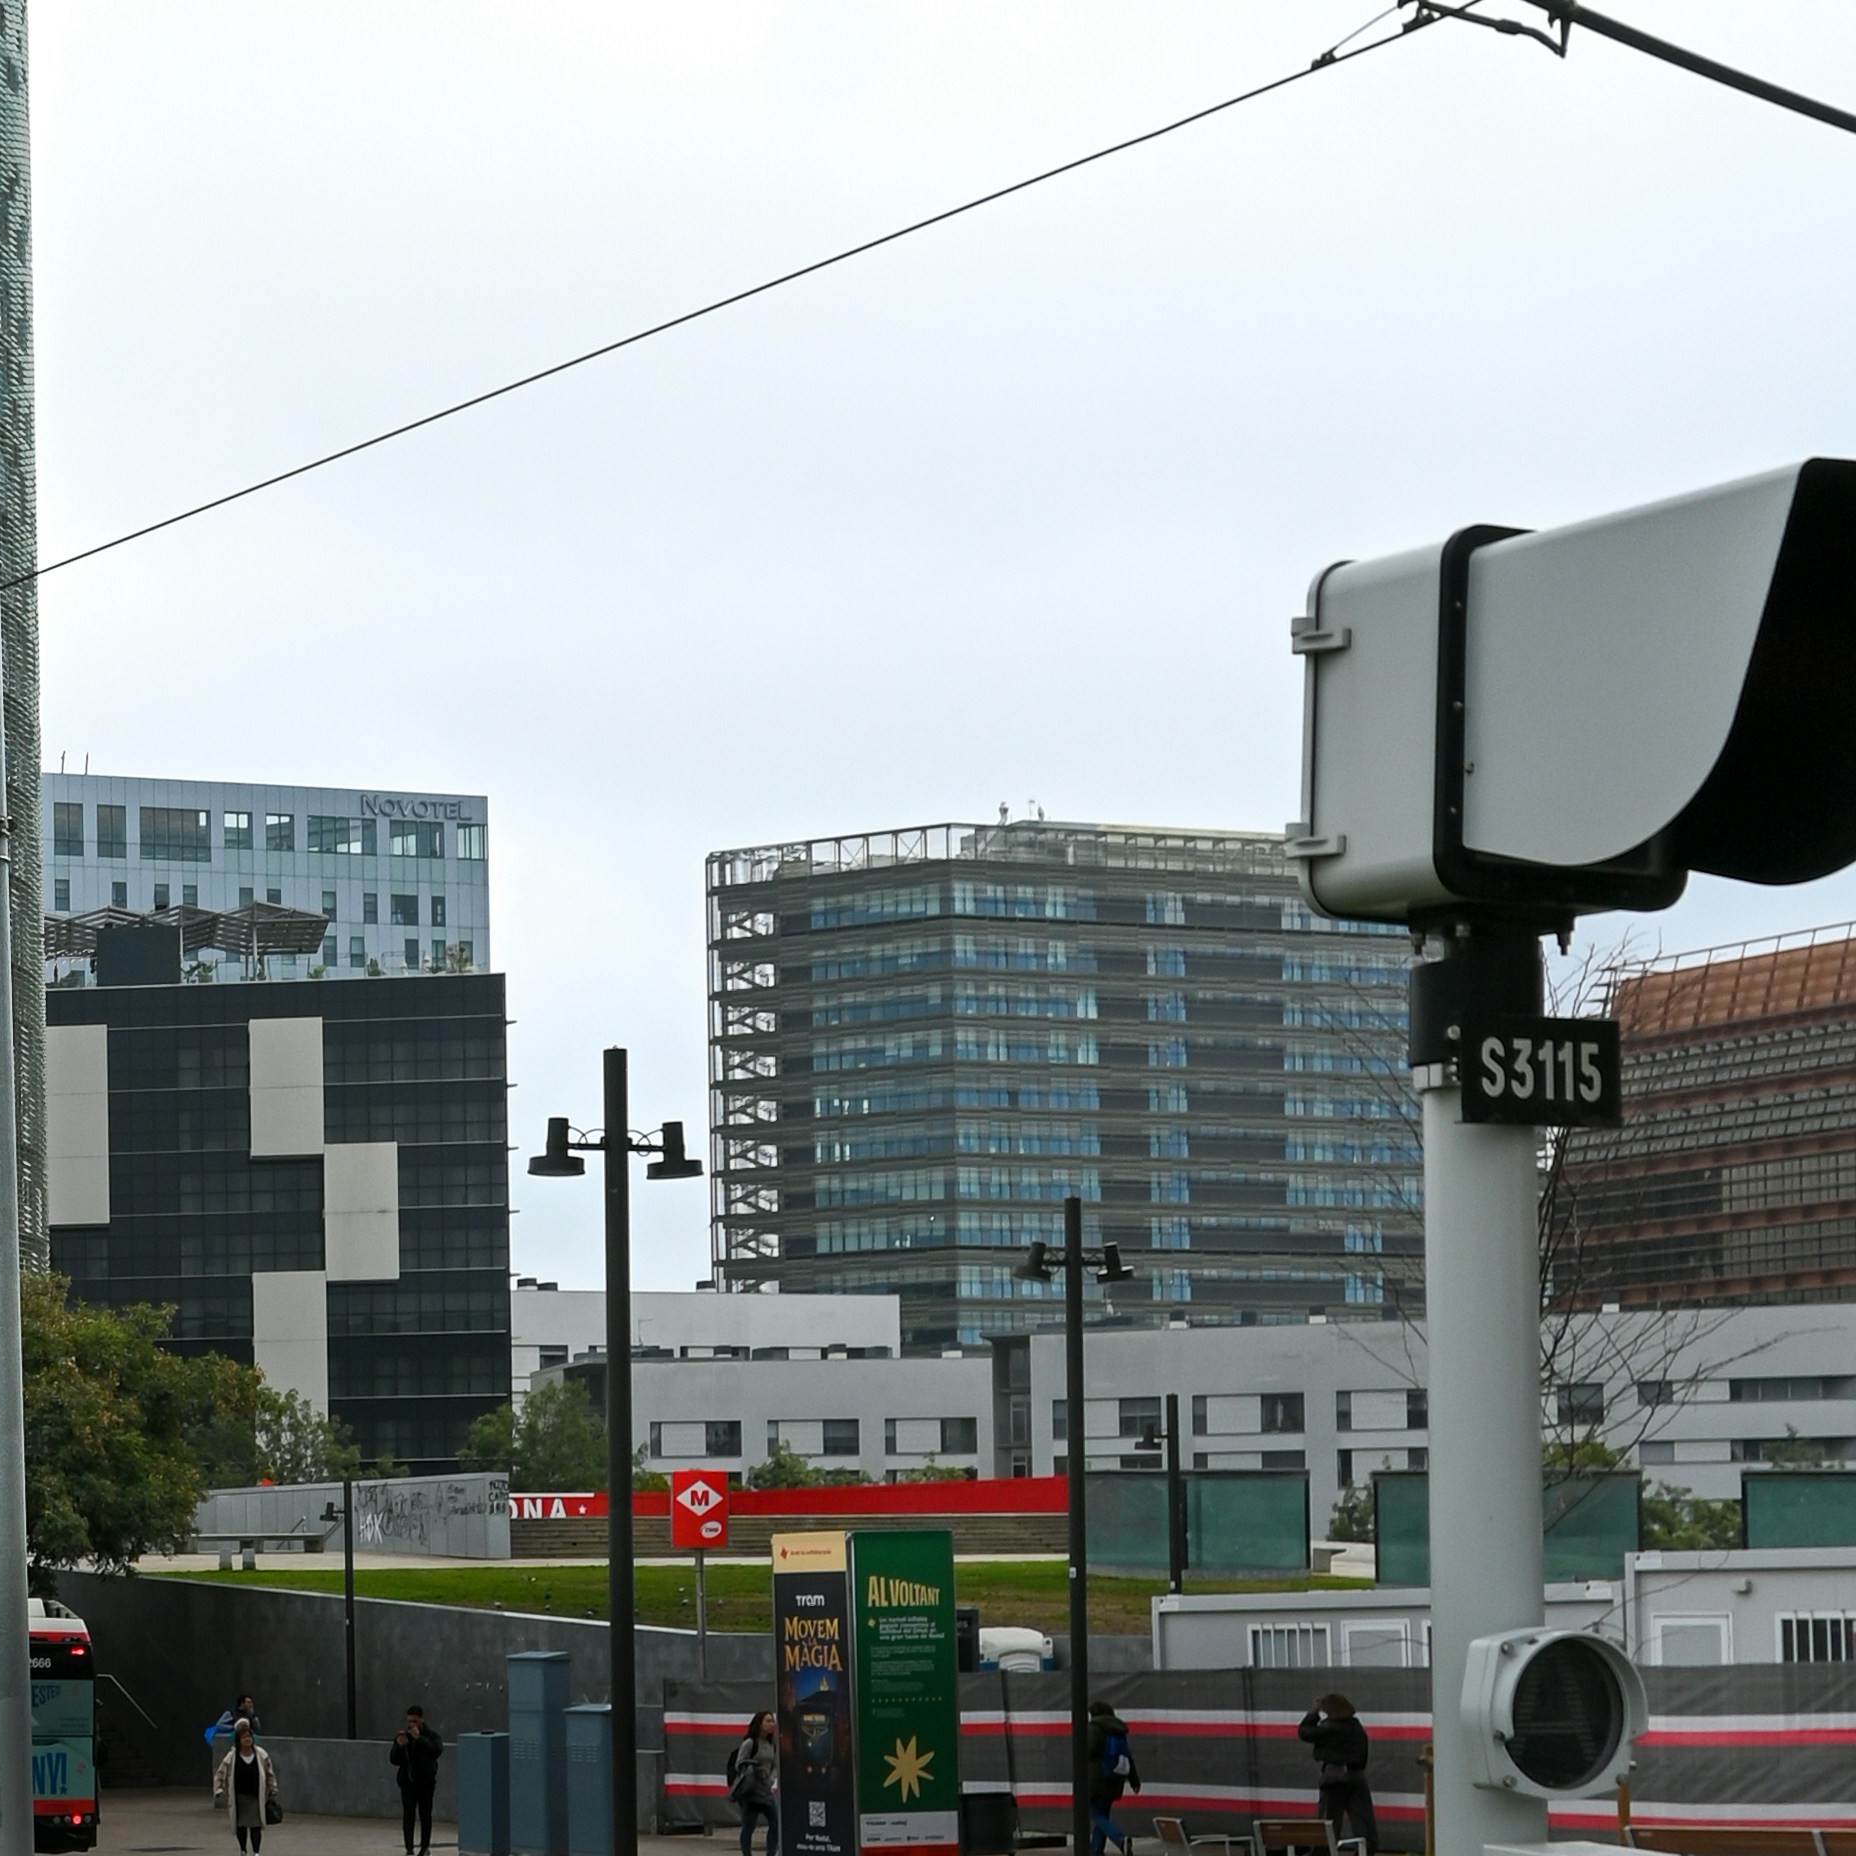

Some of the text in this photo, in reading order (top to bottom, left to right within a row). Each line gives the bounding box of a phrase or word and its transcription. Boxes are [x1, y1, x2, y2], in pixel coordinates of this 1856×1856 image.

[360, 794, 472, 821] NOVOTEL
[1481, 1036, 1602, 1103] S3115
[690, 1490, 710, 1506] M
[868, 1576, 941, 1607] AL VOLTANT
